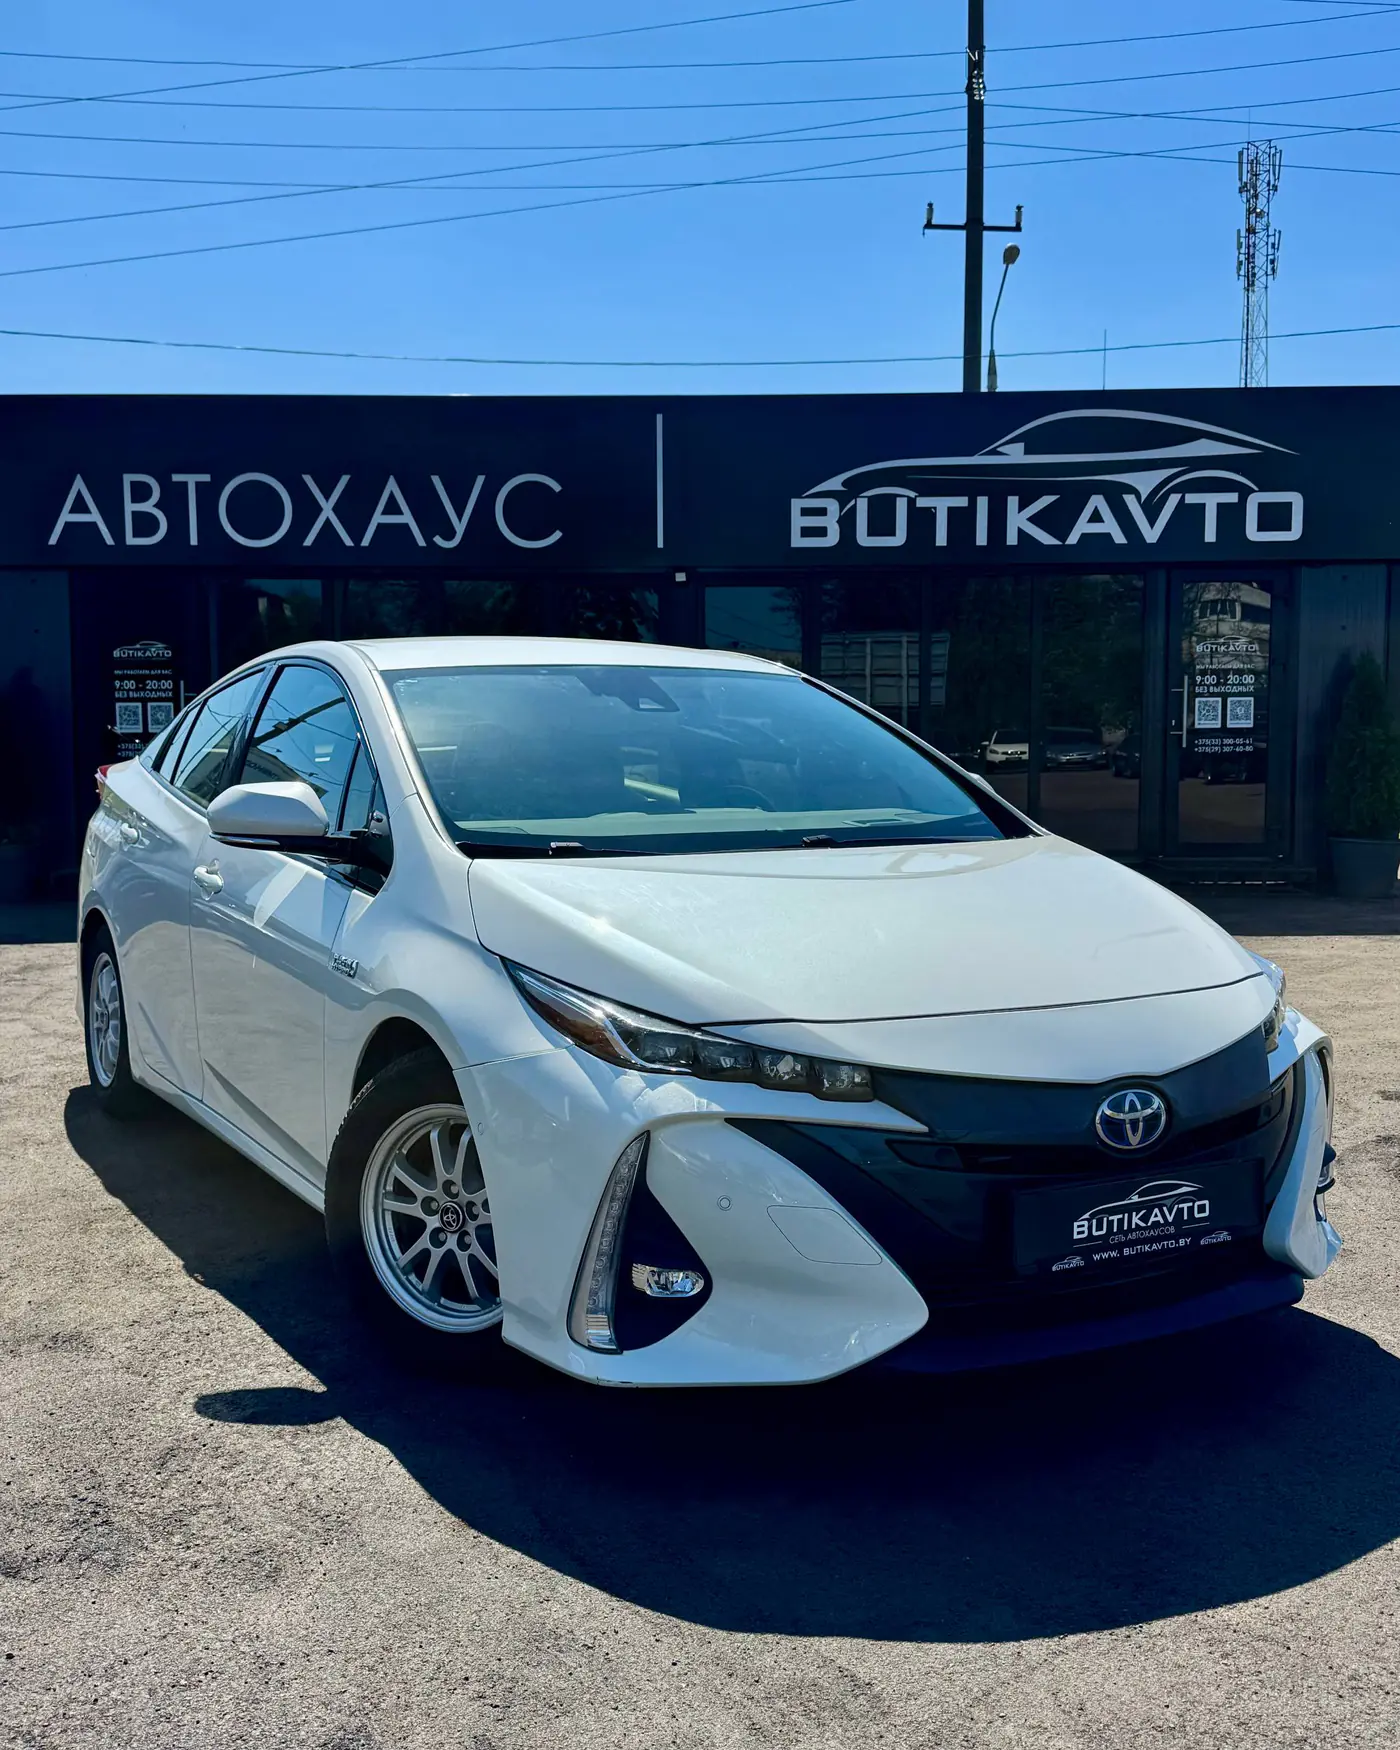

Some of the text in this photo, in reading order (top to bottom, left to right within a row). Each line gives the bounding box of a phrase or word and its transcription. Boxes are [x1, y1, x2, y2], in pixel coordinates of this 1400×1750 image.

[48, 471, 563, 548] АВТОХАУС
[790, 491, 1304, 548] BUTIKAVTO
[1196, 643, 1255, 652] BUTIKAVTO
[113, 649, 172, 658] BUTIKAVTO
[1195, 675, 1217, 684] 9:00
[1227, 674, 1255, 684] 20:00
[114, 680, 136, 689] 9:00
[145, 680, 173, 689] 20:00
[1195, 685, 1208, 693] БЕЗ
[1073, 1200, 1210, 1239] BUTIKAVTO
[1109, 1226, 1176, 1244] СЕТЬ АВТОХАУСОВ
[1200, 1235, 1232, 1245] BUTIKAVTO
[1123, 1237, 1192, 1256] BUTIKAVTO.BY
[1052, 1260, 1085, 1271] BUTIKAVTO
